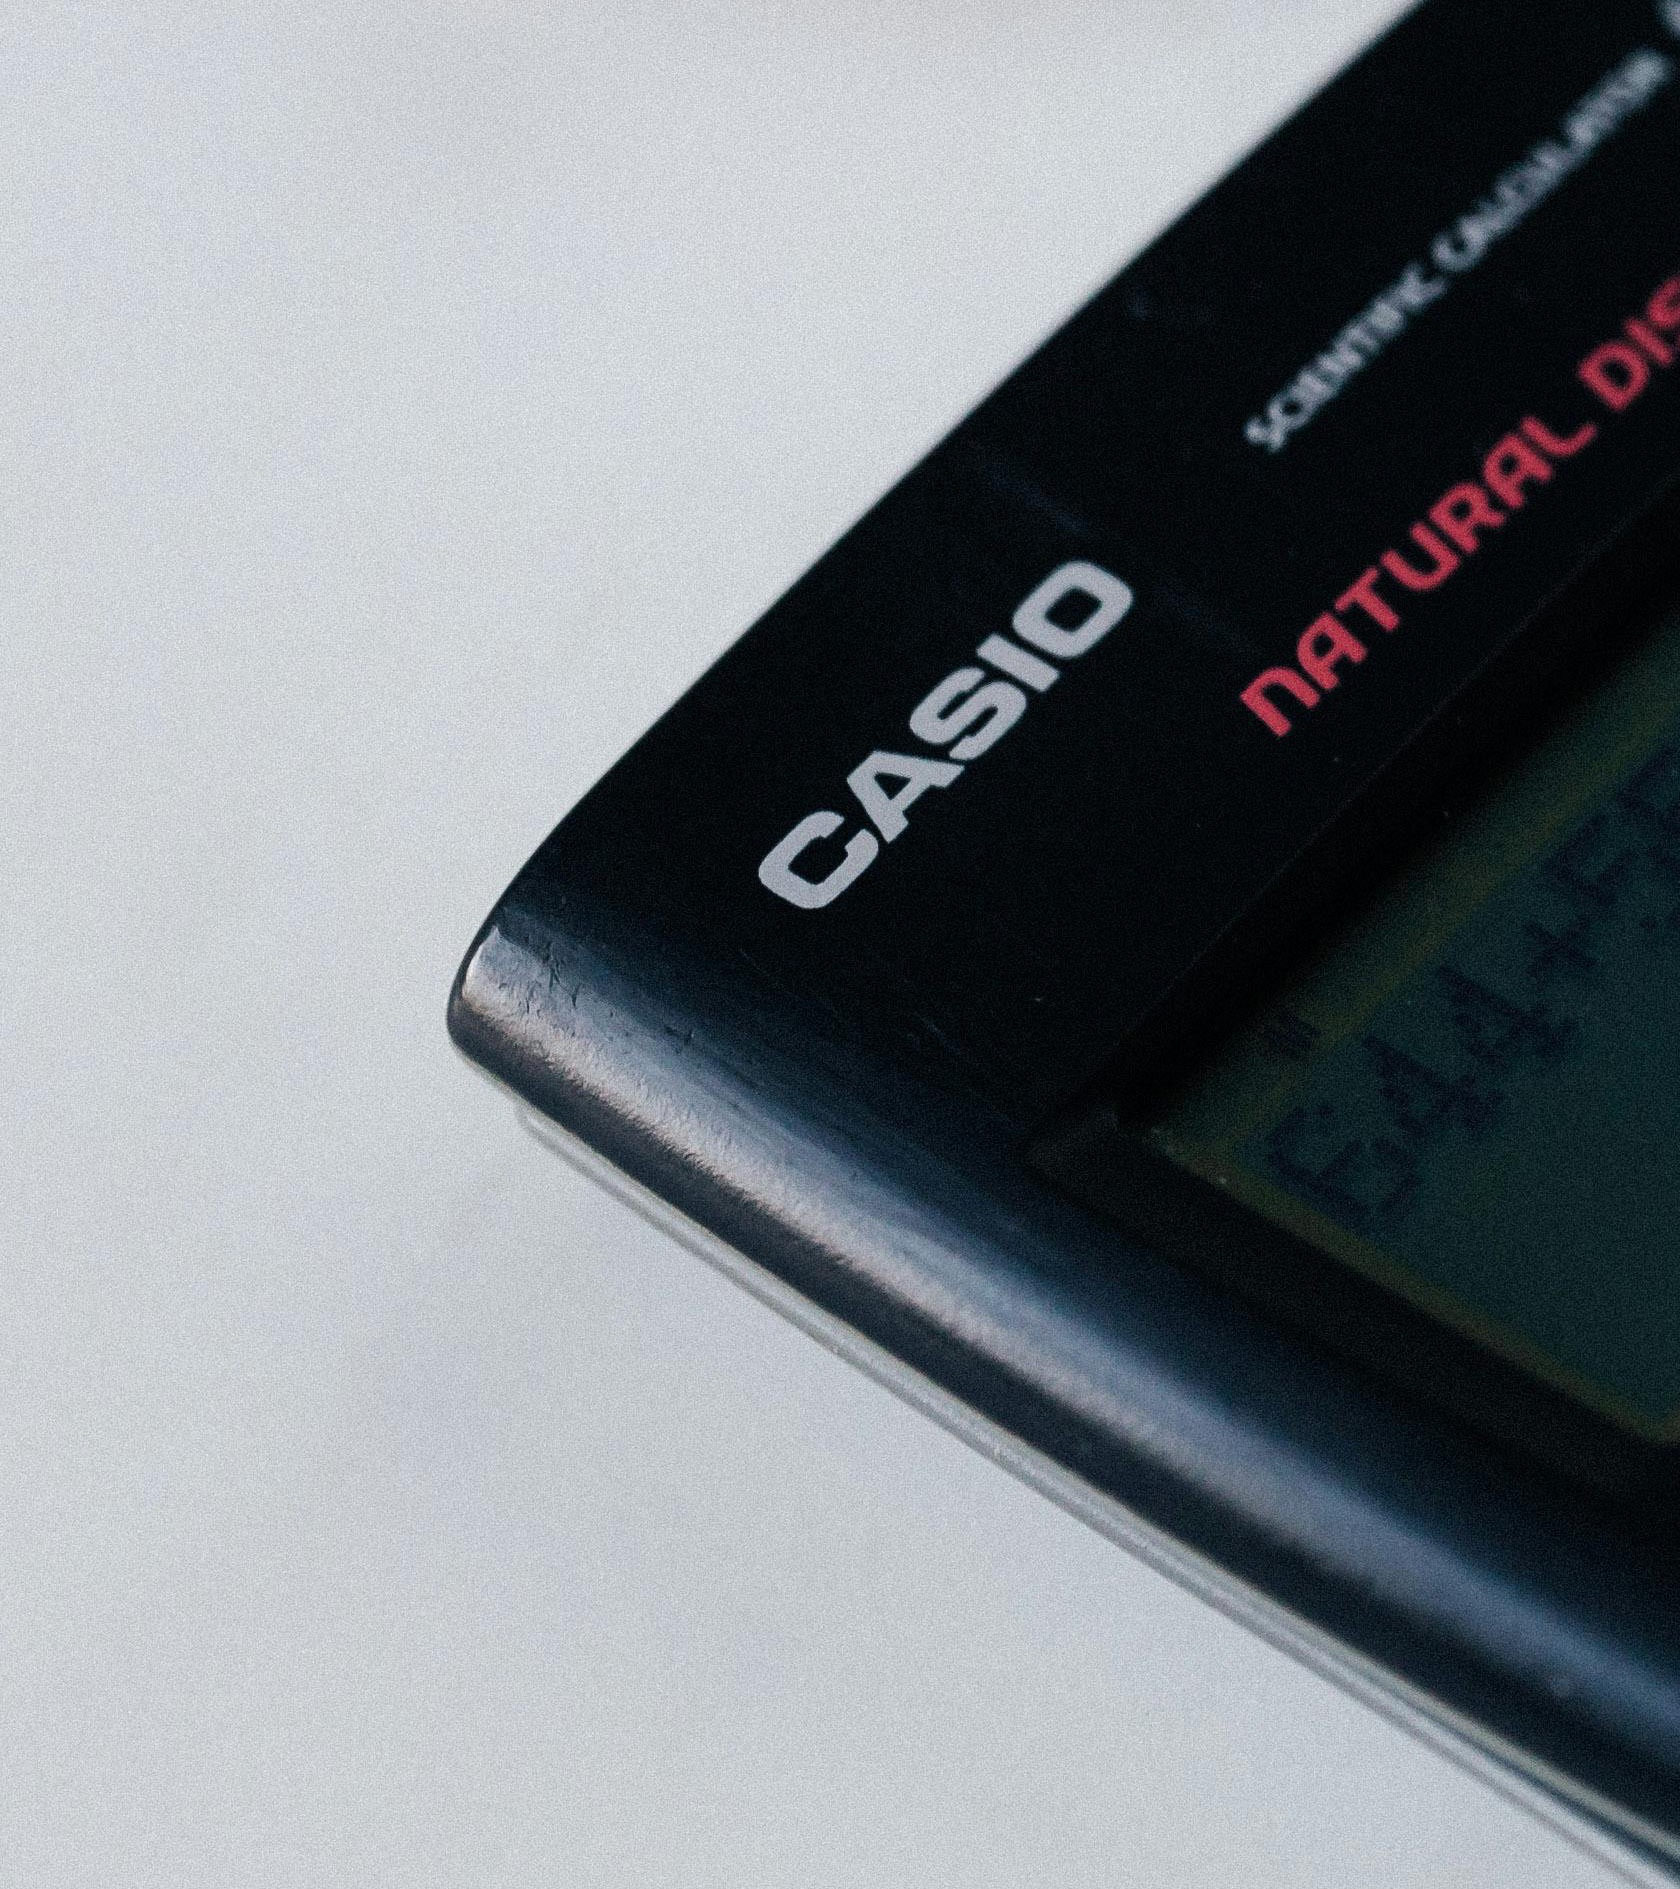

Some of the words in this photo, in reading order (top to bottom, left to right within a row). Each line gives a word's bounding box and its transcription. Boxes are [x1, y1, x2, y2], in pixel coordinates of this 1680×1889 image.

[1244, 267, 1441, 451] SCIENTIFIC
[1432, 51, 1668, 271] CALCULATOR
[758, 559, 1133, 909] CASIO
[1240, 413, 1596, 737] NATURAL
